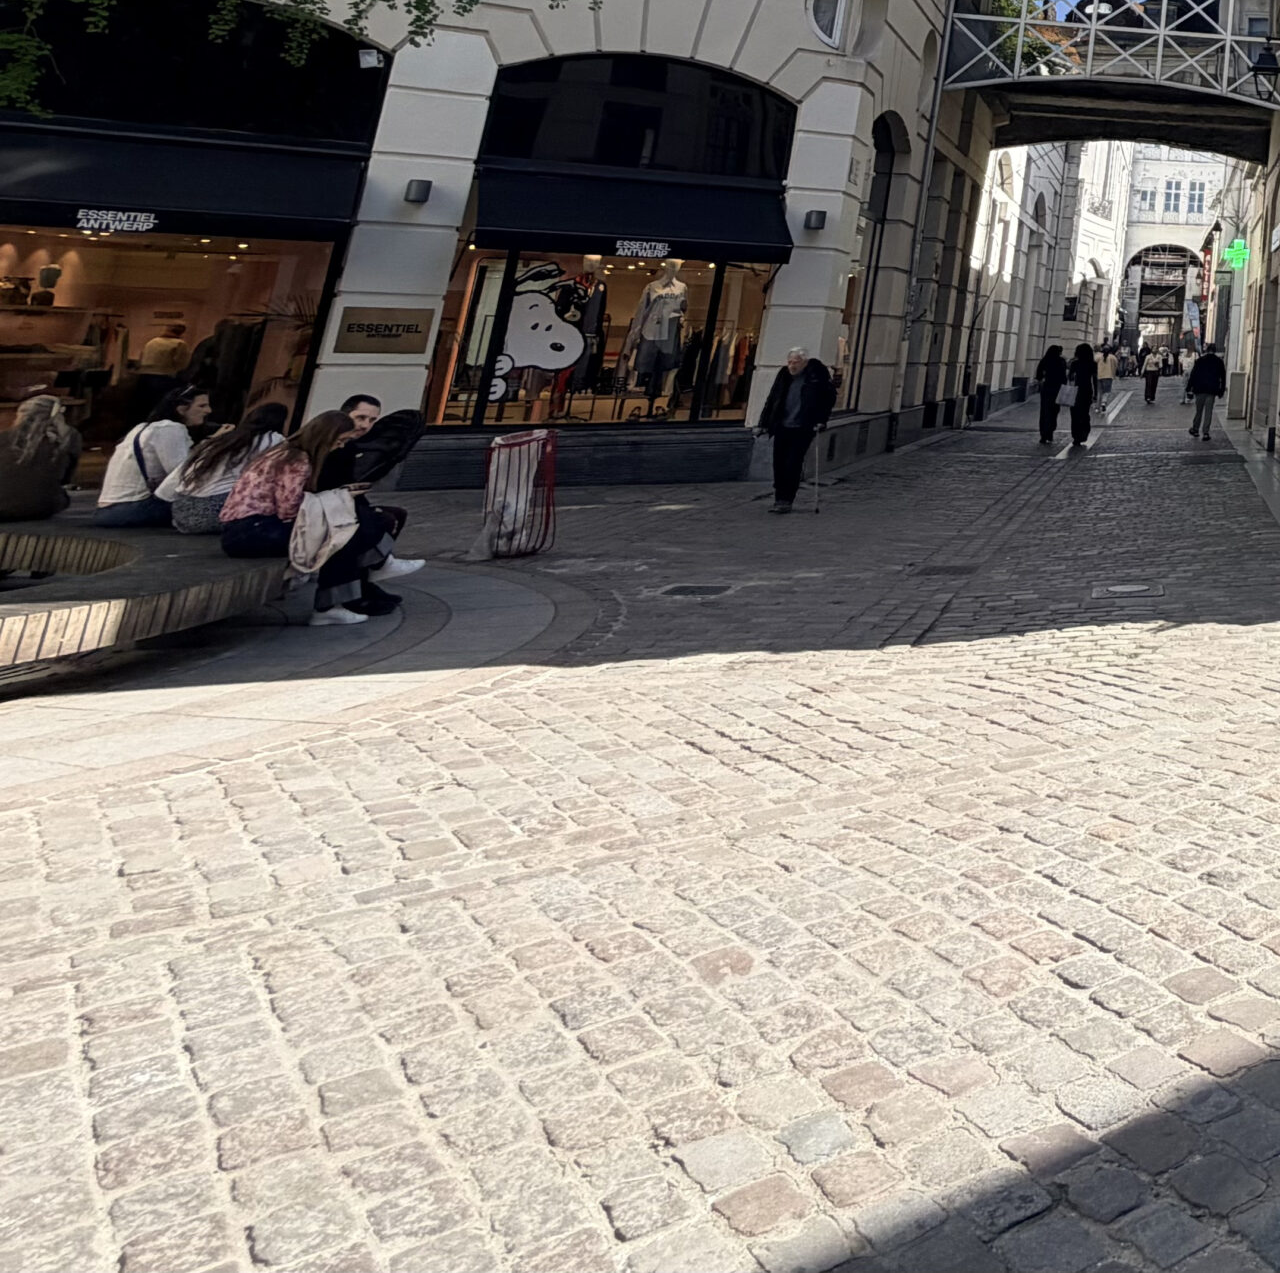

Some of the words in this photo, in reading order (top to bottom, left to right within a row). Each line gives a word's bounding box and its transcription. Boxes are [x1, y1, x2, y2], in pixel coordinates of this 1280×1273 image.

[77, 209, 159, 223] ESSENTIEL
[76, 219, 154, 231] ANTWERP
[616, 240, 671, 251] ESSENTIEL
[616, 248, 668, 257] ANTWERP
[347, 323, 422, 334] ESSENTIEL
